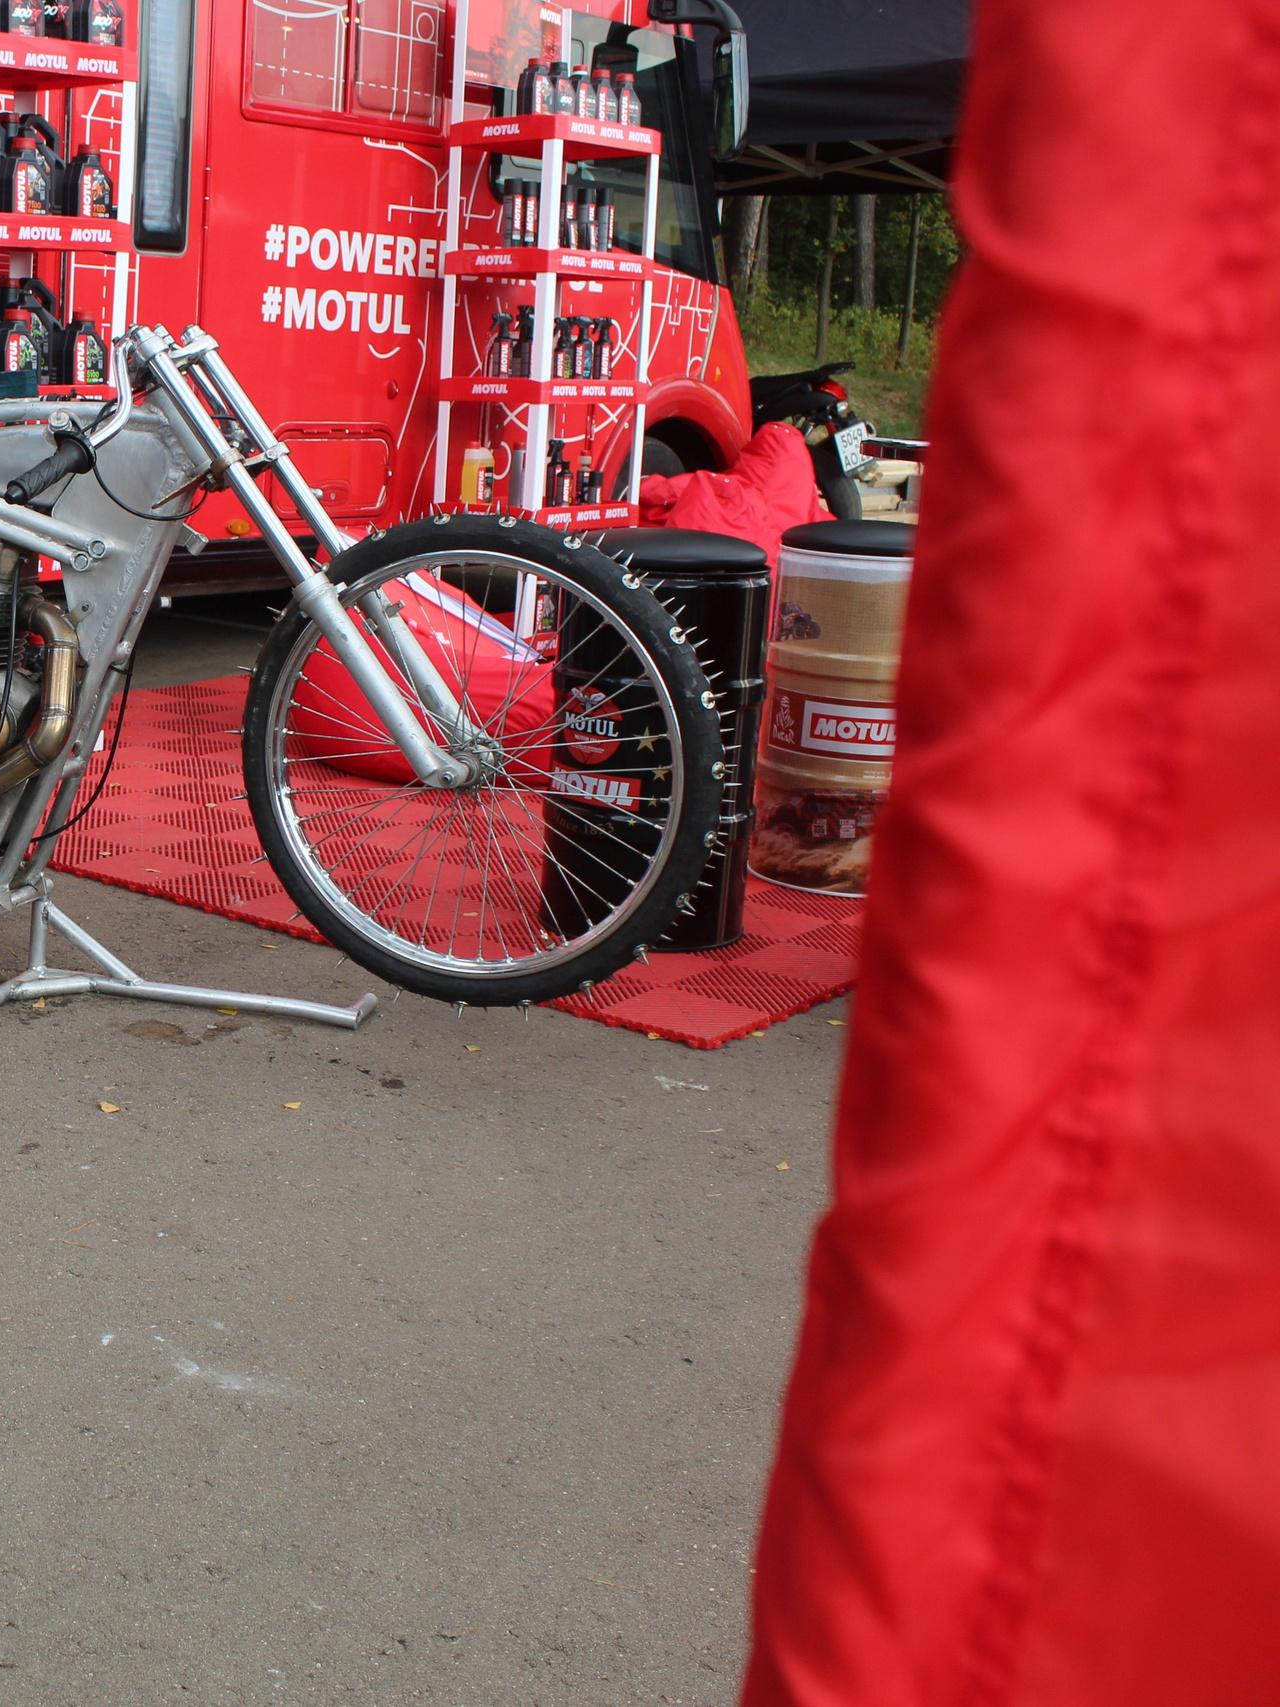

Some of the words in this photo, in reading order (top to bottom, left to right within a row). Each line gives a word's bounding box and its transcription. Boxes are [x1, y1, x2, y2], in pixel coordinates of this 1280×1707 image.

[540, 8, 562, 26] MOTUL
[24, 53, 68, 70] MOTUL
[77, 58, 119, 74] MOTUL
[483, 124, 520, 137] MOTUL
[571, 122, 596, 135] MOTUL
[600, 126, 624, 140] MOTUL
[628, 131, 652, 144] MOTUL
[17, 169, 26, 213] MOTUL
[82, 174, 92, 217] MOTUL
[514, 197, 522, 230] MOTUL
[526, 199, 535, 232] MOTUL
[18, 226, 62, 241] MOTUL
[70, 228, 113, 243] MOTUL
[476, 254, 512, 266] MOTUL
[561, 255, 586, 268] MOTUL
[591, 258, 614, 271] MOTUL
[619, 261, 642, 274] MOTUL
[261, 285, 411, 334] #MOTUL
[9, 340, 18, 372] OTUL
[76, 340, 85, 383] MOTUL
[501, 344, 509, 374] MOTUL
[602, 347, 610, 376] MOTUL
[472, 384, 508, 395] MOTUL
[552, 386, 577, 396] MOTUL
[582, 386, 606, 396] MOTUL
[611, 387, 634, 397] MOTUL
[841, 428, 863, 448] 5049
[547, 512, 572, 525] MOTUL
[577, 510, 601, 522] MOTUL
[605, 508, 628, 519] MOTUL
[565, 711, 619, 738] MOTUL
[814, 718, 897, 742] MOTUL
[552, 766, 633, 806] MOTUL
